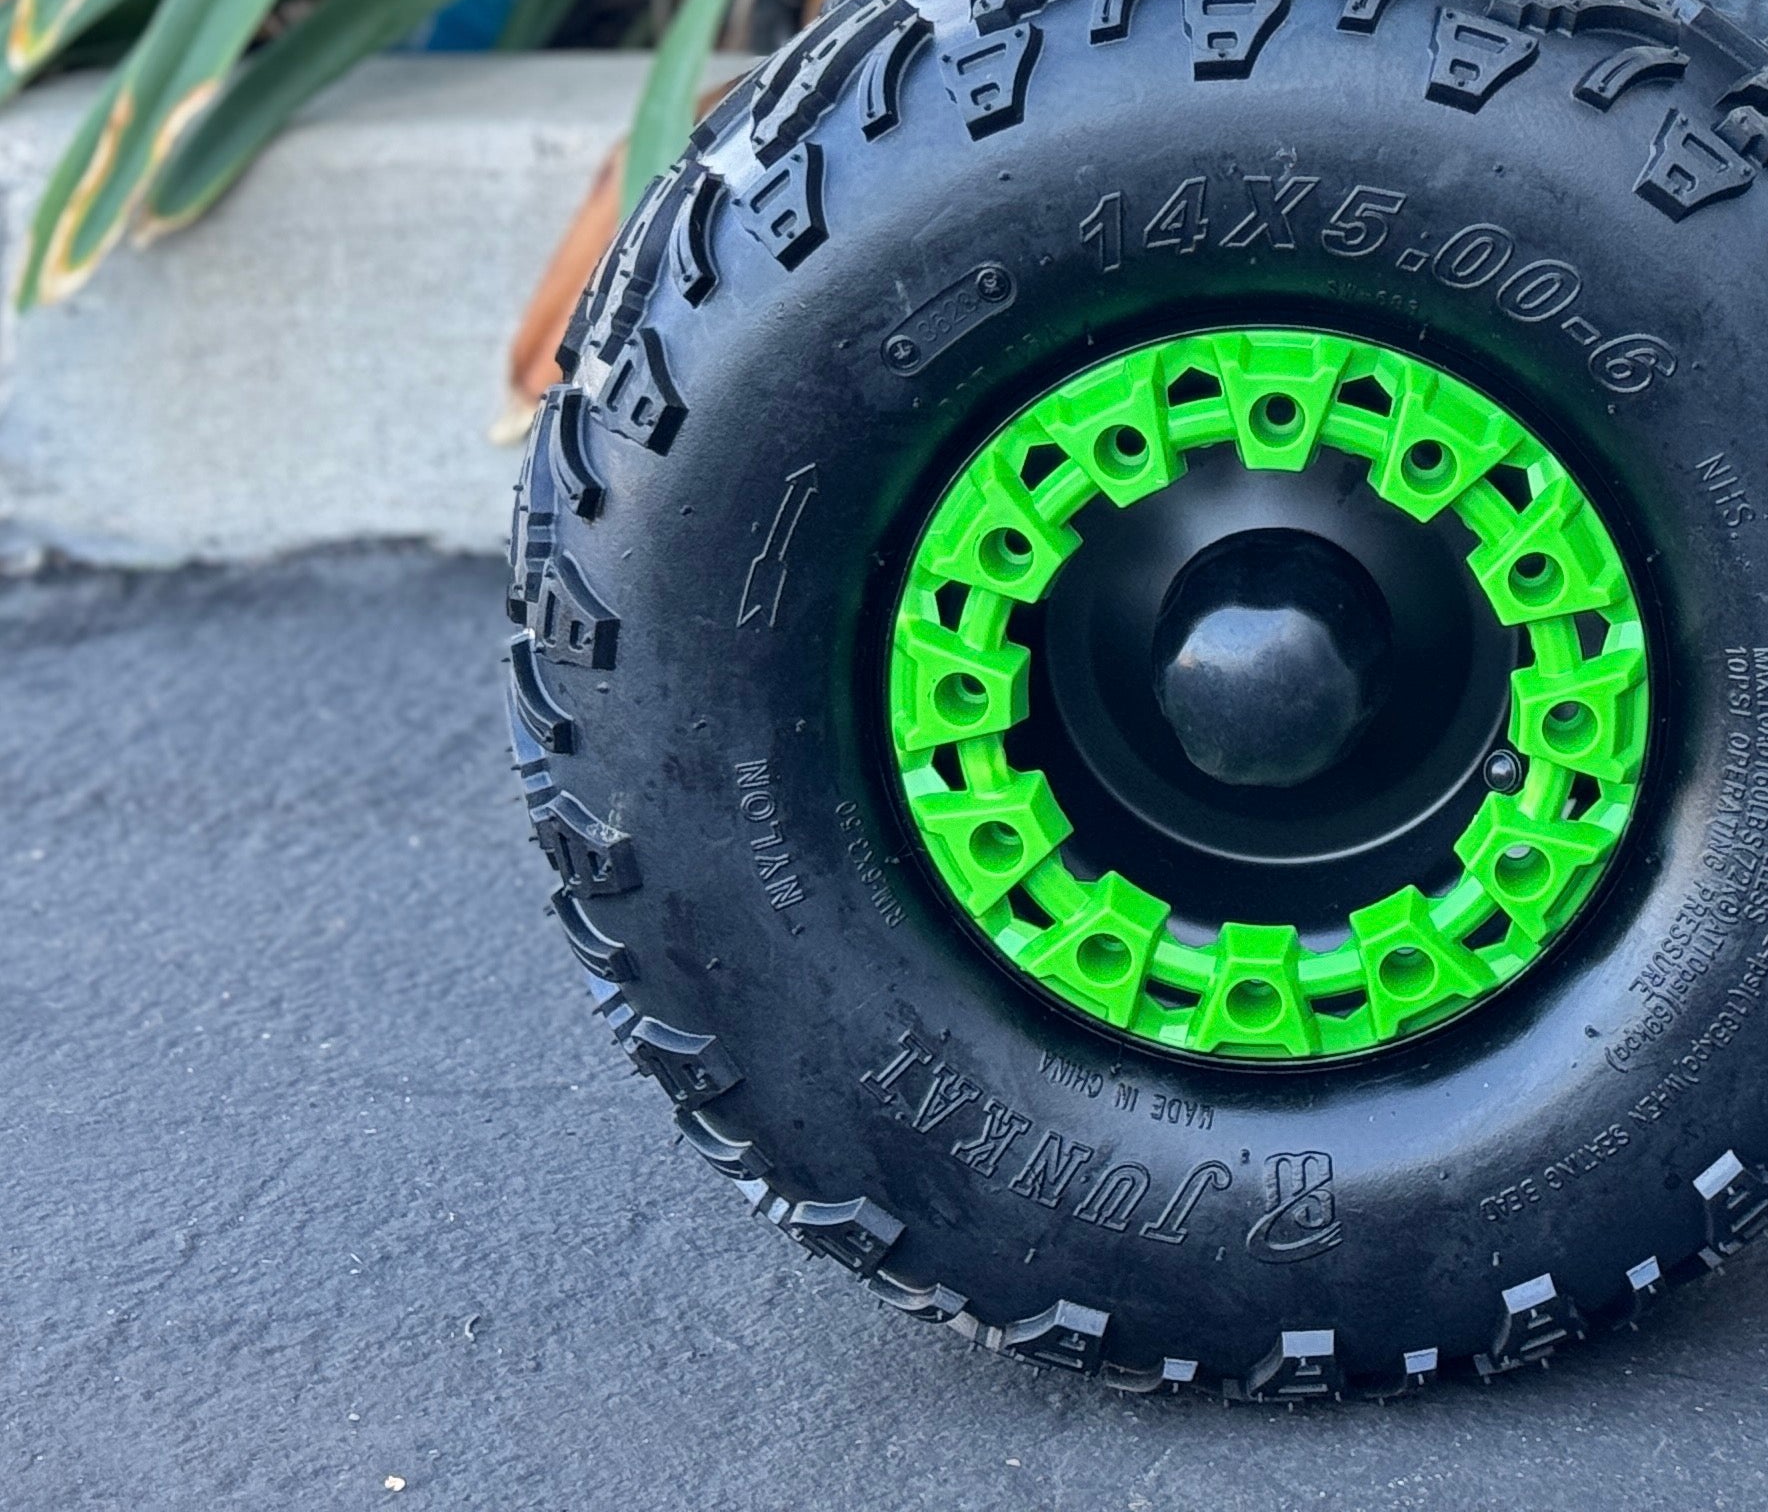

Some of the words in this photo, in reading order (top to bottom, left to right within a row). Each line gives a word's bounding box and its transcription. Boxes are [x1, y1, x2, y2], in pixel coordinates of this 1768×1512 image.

[1077, 174, 1678, 394] 14X5.00-6
[736, 757, 804, 912] NYLON
[1703, 731, 1749, 873] OPERATING
[1628, 880, 1715, 1003] PRESSURE
[1036, 1049, 1103, 1100] CHINA
[1112, 1082, 1140, 1113] IN
[1149, 1094, 1213, 1131] MADE
[859, 1031, 1232, 1243] JUNKAI
[1544, 1122, 1631, 1192] SEATING
